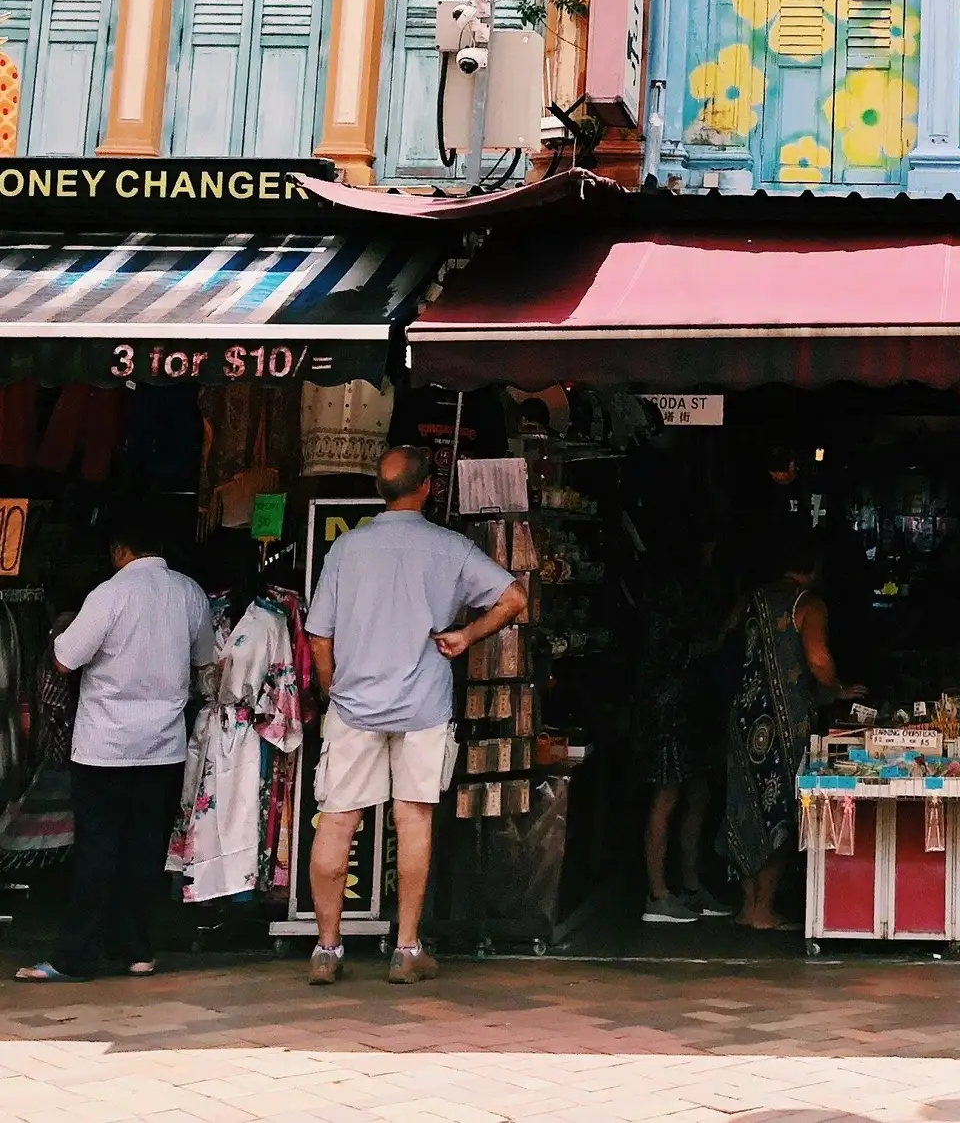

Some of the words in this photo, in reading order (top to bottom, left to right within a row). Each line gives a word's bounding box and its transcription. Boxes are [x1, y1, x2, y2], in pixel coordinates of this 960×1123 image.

[110, 344, 134, 377] 3
[149, 345, 208, 377] for
[222, 344, 333, 381] $10/=
[691, 397, 706, 409] ST
